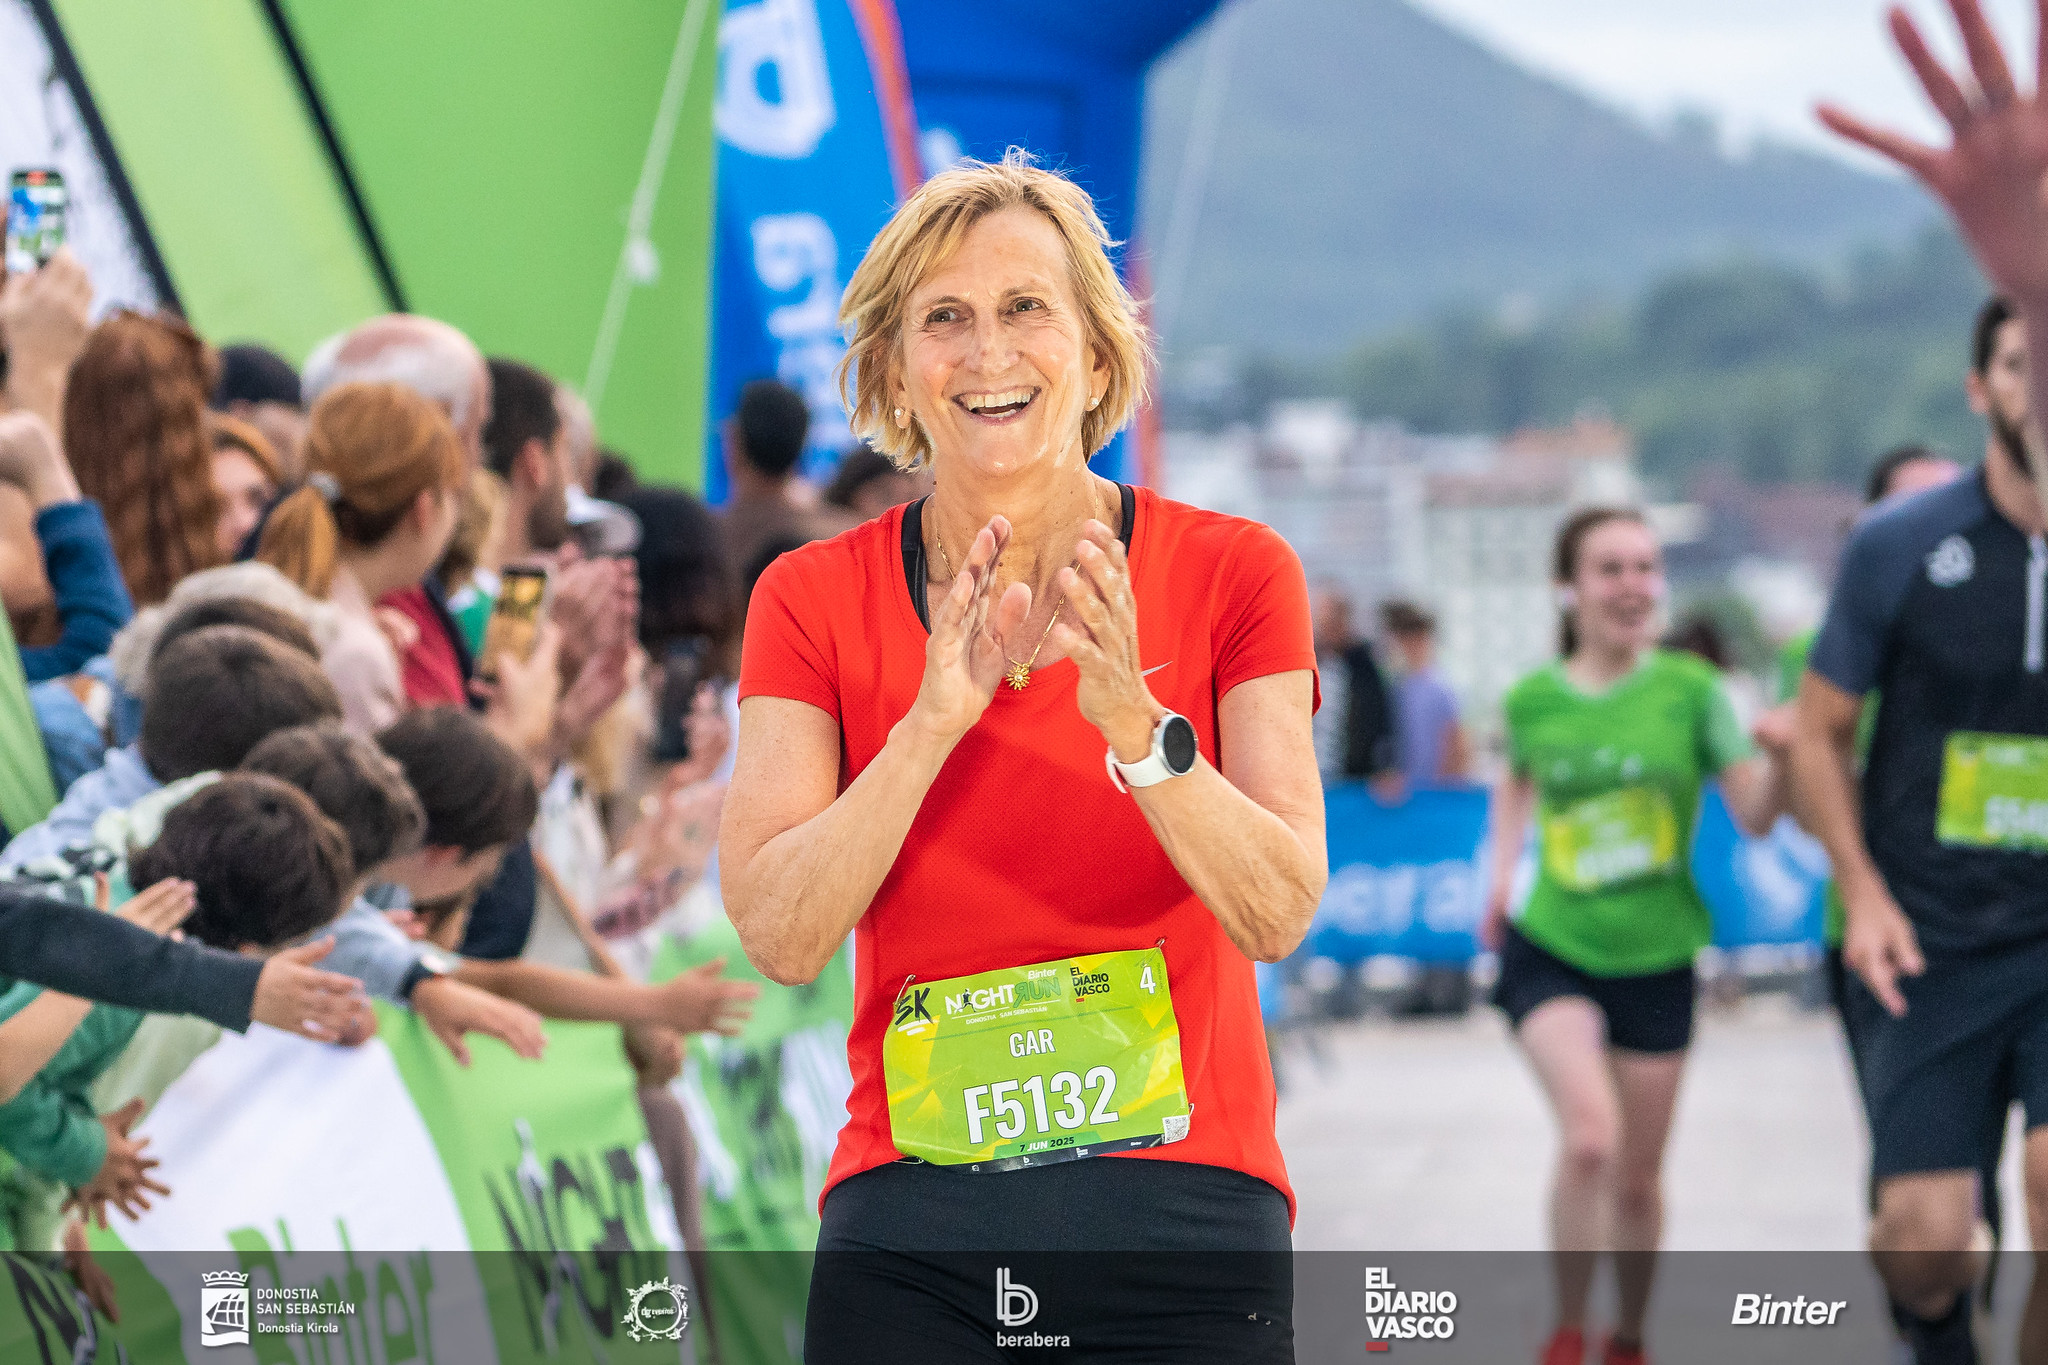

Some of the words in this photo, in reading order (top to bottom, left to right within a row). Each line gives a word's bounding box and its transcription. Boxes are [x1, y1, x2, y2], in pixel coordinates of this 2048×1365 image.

[1028, 968, 1057, 980] Binter
[1070, 967, 1083, 976] EL
[1072, 973, 1109, 987] DIARIO
[1140, 966, 1156, 994] 4
[1074, 984, 1110, 997] VASCO
[895, 987, 934, 1025] 5K
[966, 1014, 997, 1025] DONOSTIA
[1000, 1010, 1013, 1019] SAN
[1009, 1028, 1056, 1057] GAR
[963, 1066, 1119, 1145] F5132
[1019, 1144, 1026, 1152] 7
[1027, 1140, 1048, 1152] JUN
[1050, 1136, 1075, 1148] 2025
